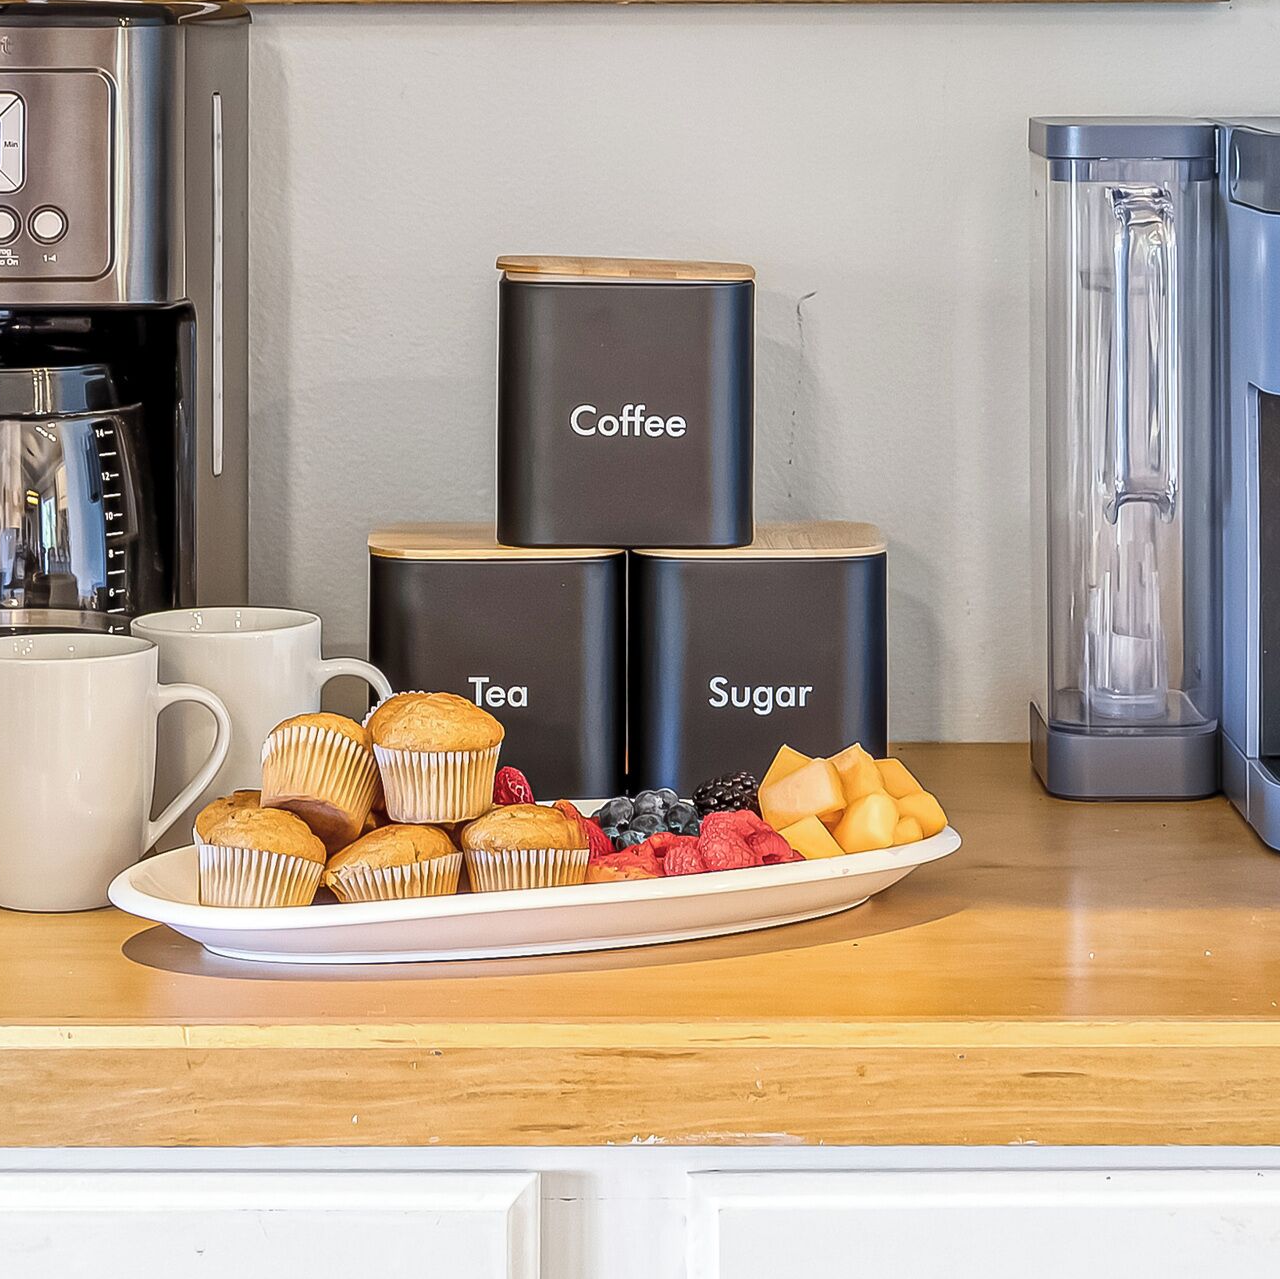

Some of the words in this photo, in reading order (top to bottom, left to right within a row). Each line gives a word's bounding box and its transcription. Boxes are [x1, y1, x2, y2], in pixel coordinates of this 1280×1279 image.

[6, 258, 19, 266] On
[569, 404, 687, 438] Coffee
[101, 471, 111, 481] 12
[105, 511, 114, 520] 10
[108, 549, 114, 558] 8
[109, 588, 115, 597] 6
[468, 676, 528, 708] Tea
[708, 676, 813, 716] Sugar
